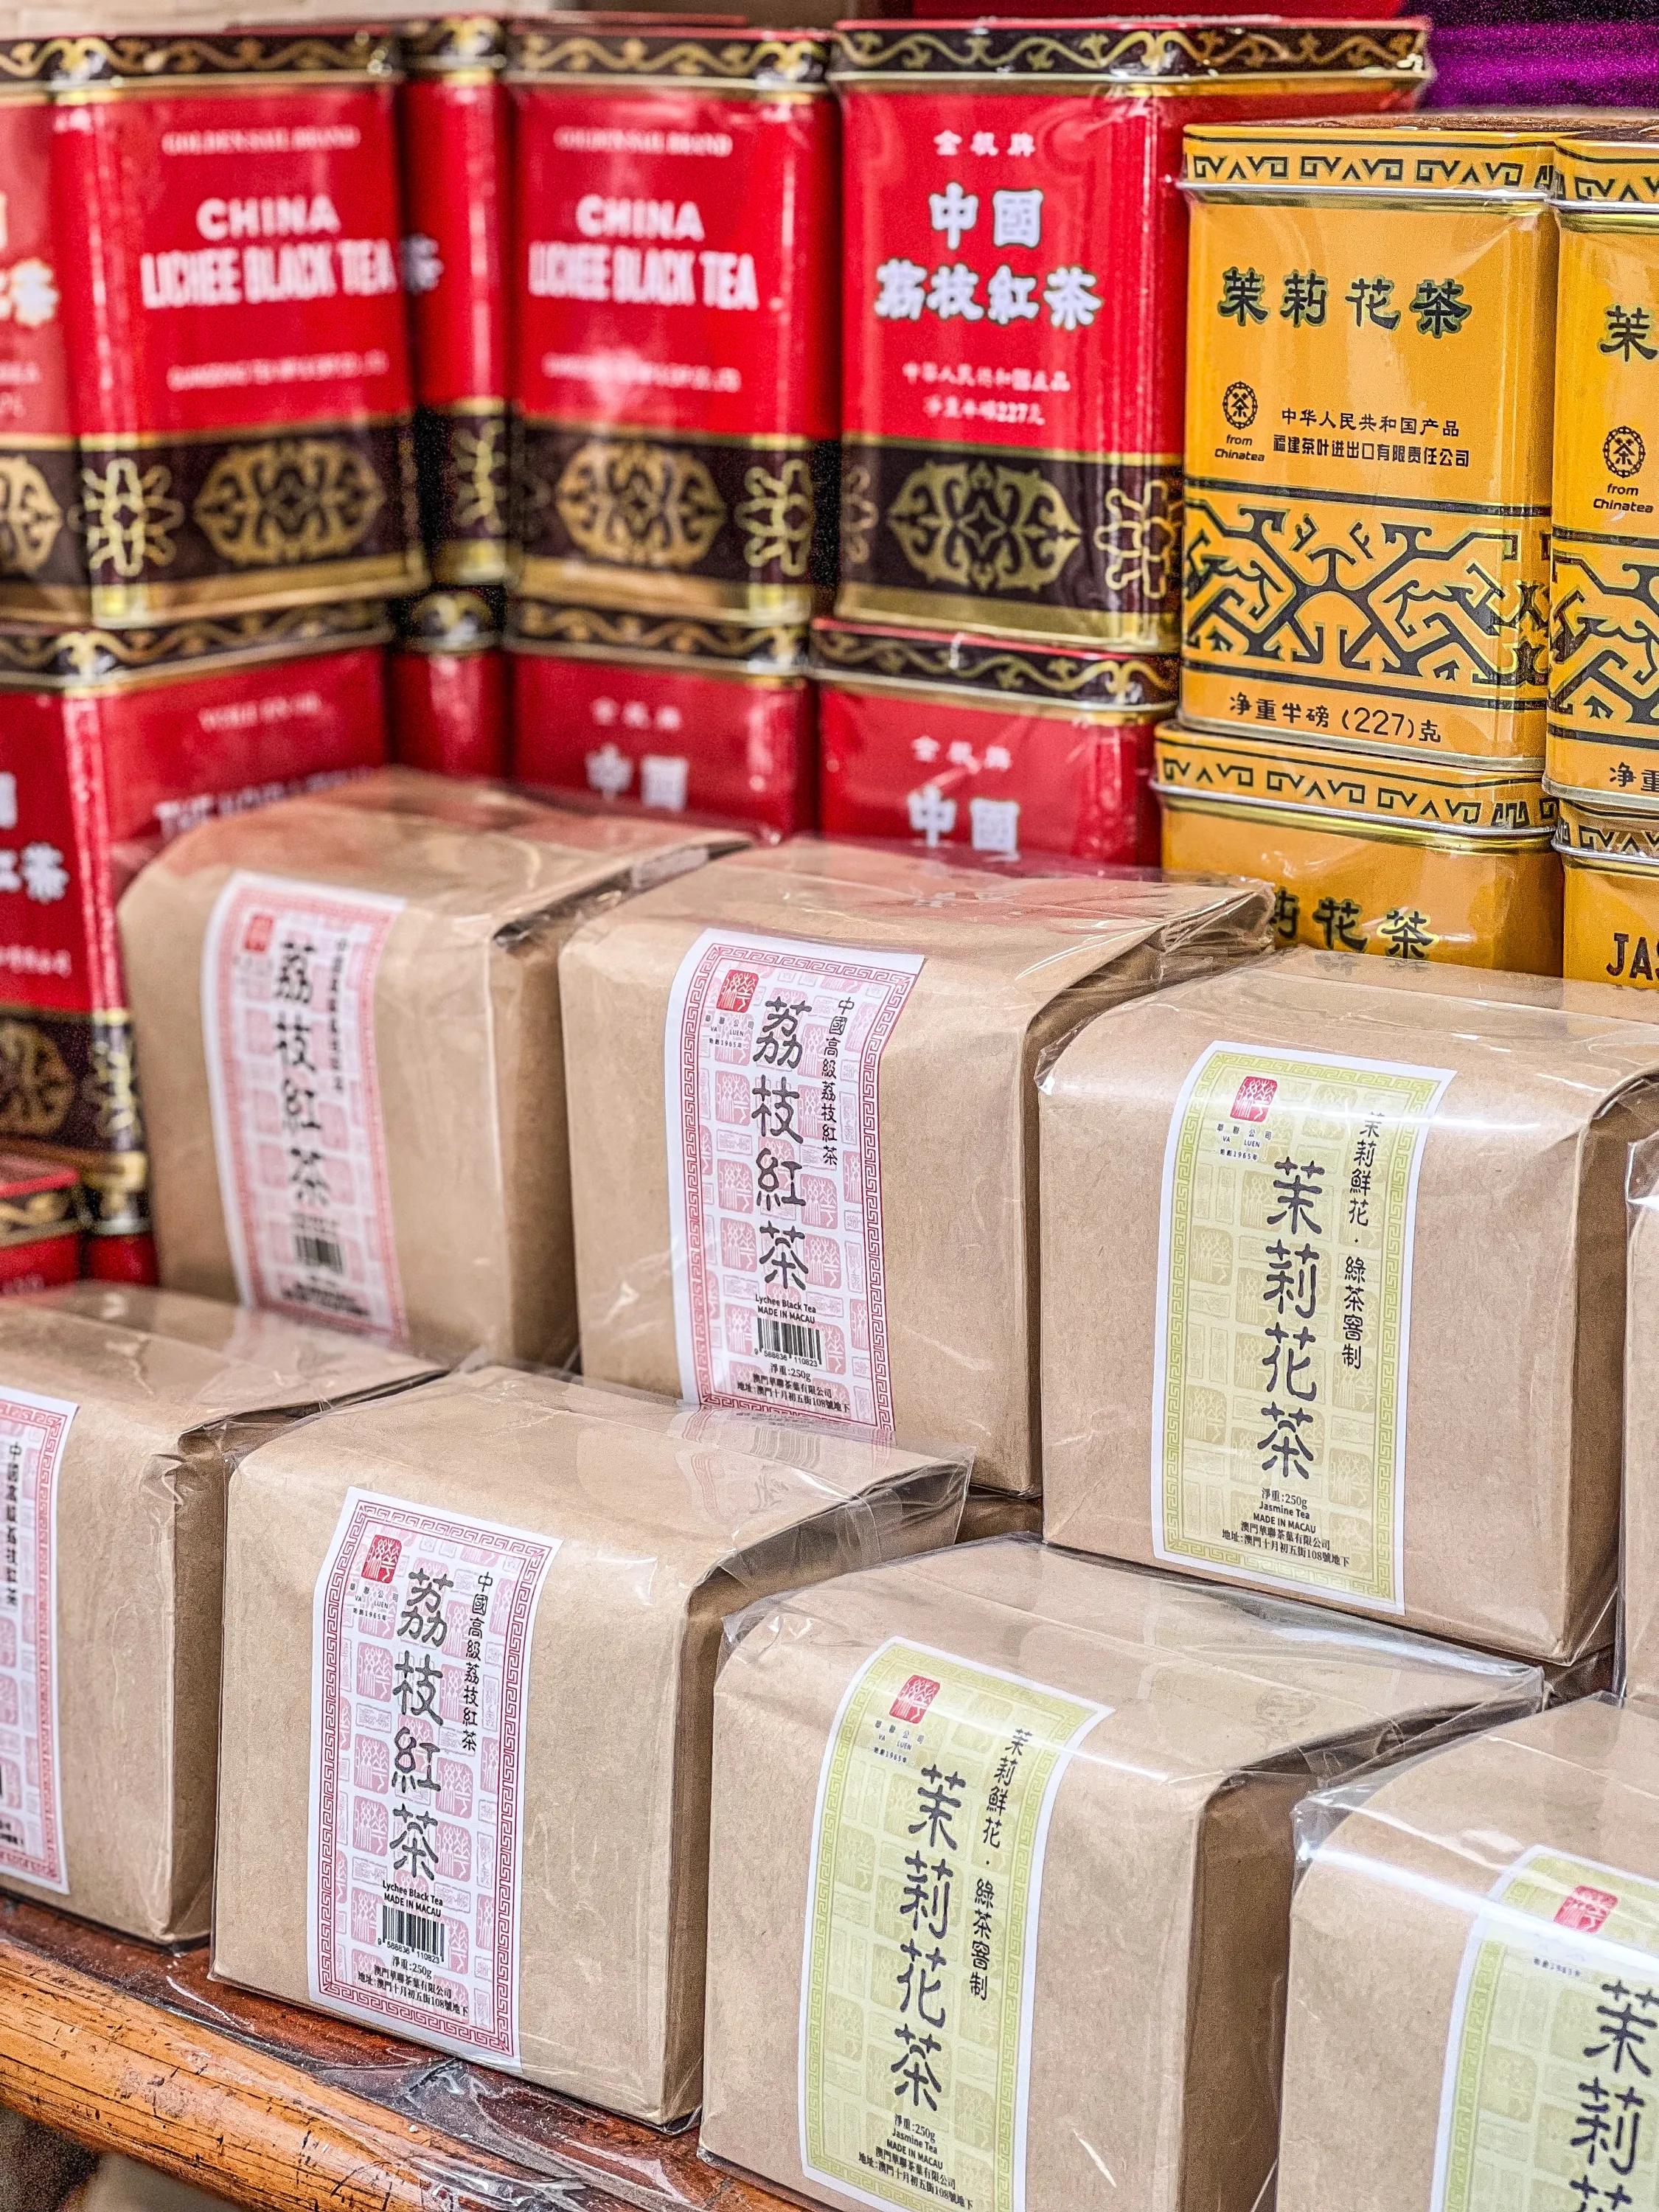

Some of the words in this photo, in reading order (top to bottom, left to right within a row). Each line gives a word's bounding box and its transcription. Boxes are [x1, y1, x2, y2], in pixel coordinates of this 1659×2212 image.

[195, 194, 341, 242] CHINA
[576, 193, 705, 242] CHINA
[928, 181, 1044, 250] 中國
[242, 240, 338, 305] BLACK
[336, 237, 399, 296] TEA
[612, 244, 696, 307] BLACK
[699, 249, 759, 311] TEA
[874, 259, 1103, 331] 荔枝紅茶
[1218, 267, 1472, 338] 茉莉花茶
[1281, 407, 1459, 437] 中华人民共和国产品
[1214, 448, 1265, 462] Chinatea
[1225, 434, 1253, 445] from
[1273, 434, 1470, 467] 福建茶叶进出口有限责任公司
[1593, 498, 1653, 514] Chinatea
[1607, 483, 1638, 496] from
[1606, 931, 1659, 981] JA
[821, 997, 855, 1166] 中國高級荔枝紅茶
[751, 996, 812, 1290] 荔枝紅茶
[755, 1294, 780, 1307] Lychee
[782, 1299, 802, 1310] Black
[803, 1304, 816, 1314] Tea
[757, 1306, 778, 1316] MADE
[779, 1310, 787, 1318] IN
[790, 1312, 815, 1324] MACAU
[1257, 1156, 1325, 1479] 茉莉花茶
[1253, 1512, 1276, 1525] MADE
[1278, 1518, 1286, 1527] IN
[1288, 1521, 1316, 1534] MACAU
[1259, 1500, 1293, 1516] Jasmine
[1295, 1509, 1310, 1520] Tea
[462, 1571, 493, 1751] 中國高級荔枝紅茶
[390, 1568, 453, 1880] 荔枝紅茶
[897, 1740, 911, 1750] LUEN
[383, 1879, 407, 1895] Lychee
[409, 1888, 429, 1902] Black
[431, 1895, 443, 1906] Tea
[384, 1893, 404, 1906] MADE
[406, 1899, 414, 1909] IN
[415, 1902, 442, 1917] MACAU
[891, 1764, 966, 2111] 茉莉花茶
[886, 2139, 906, 2154] MADE
[908, 2148, 916, 2159] IN
[917, 2152, 943, 2170] MACAU
[892, 2128, 922, 2148] Jasmine
[924, 2141, 938, 2154] Tea
